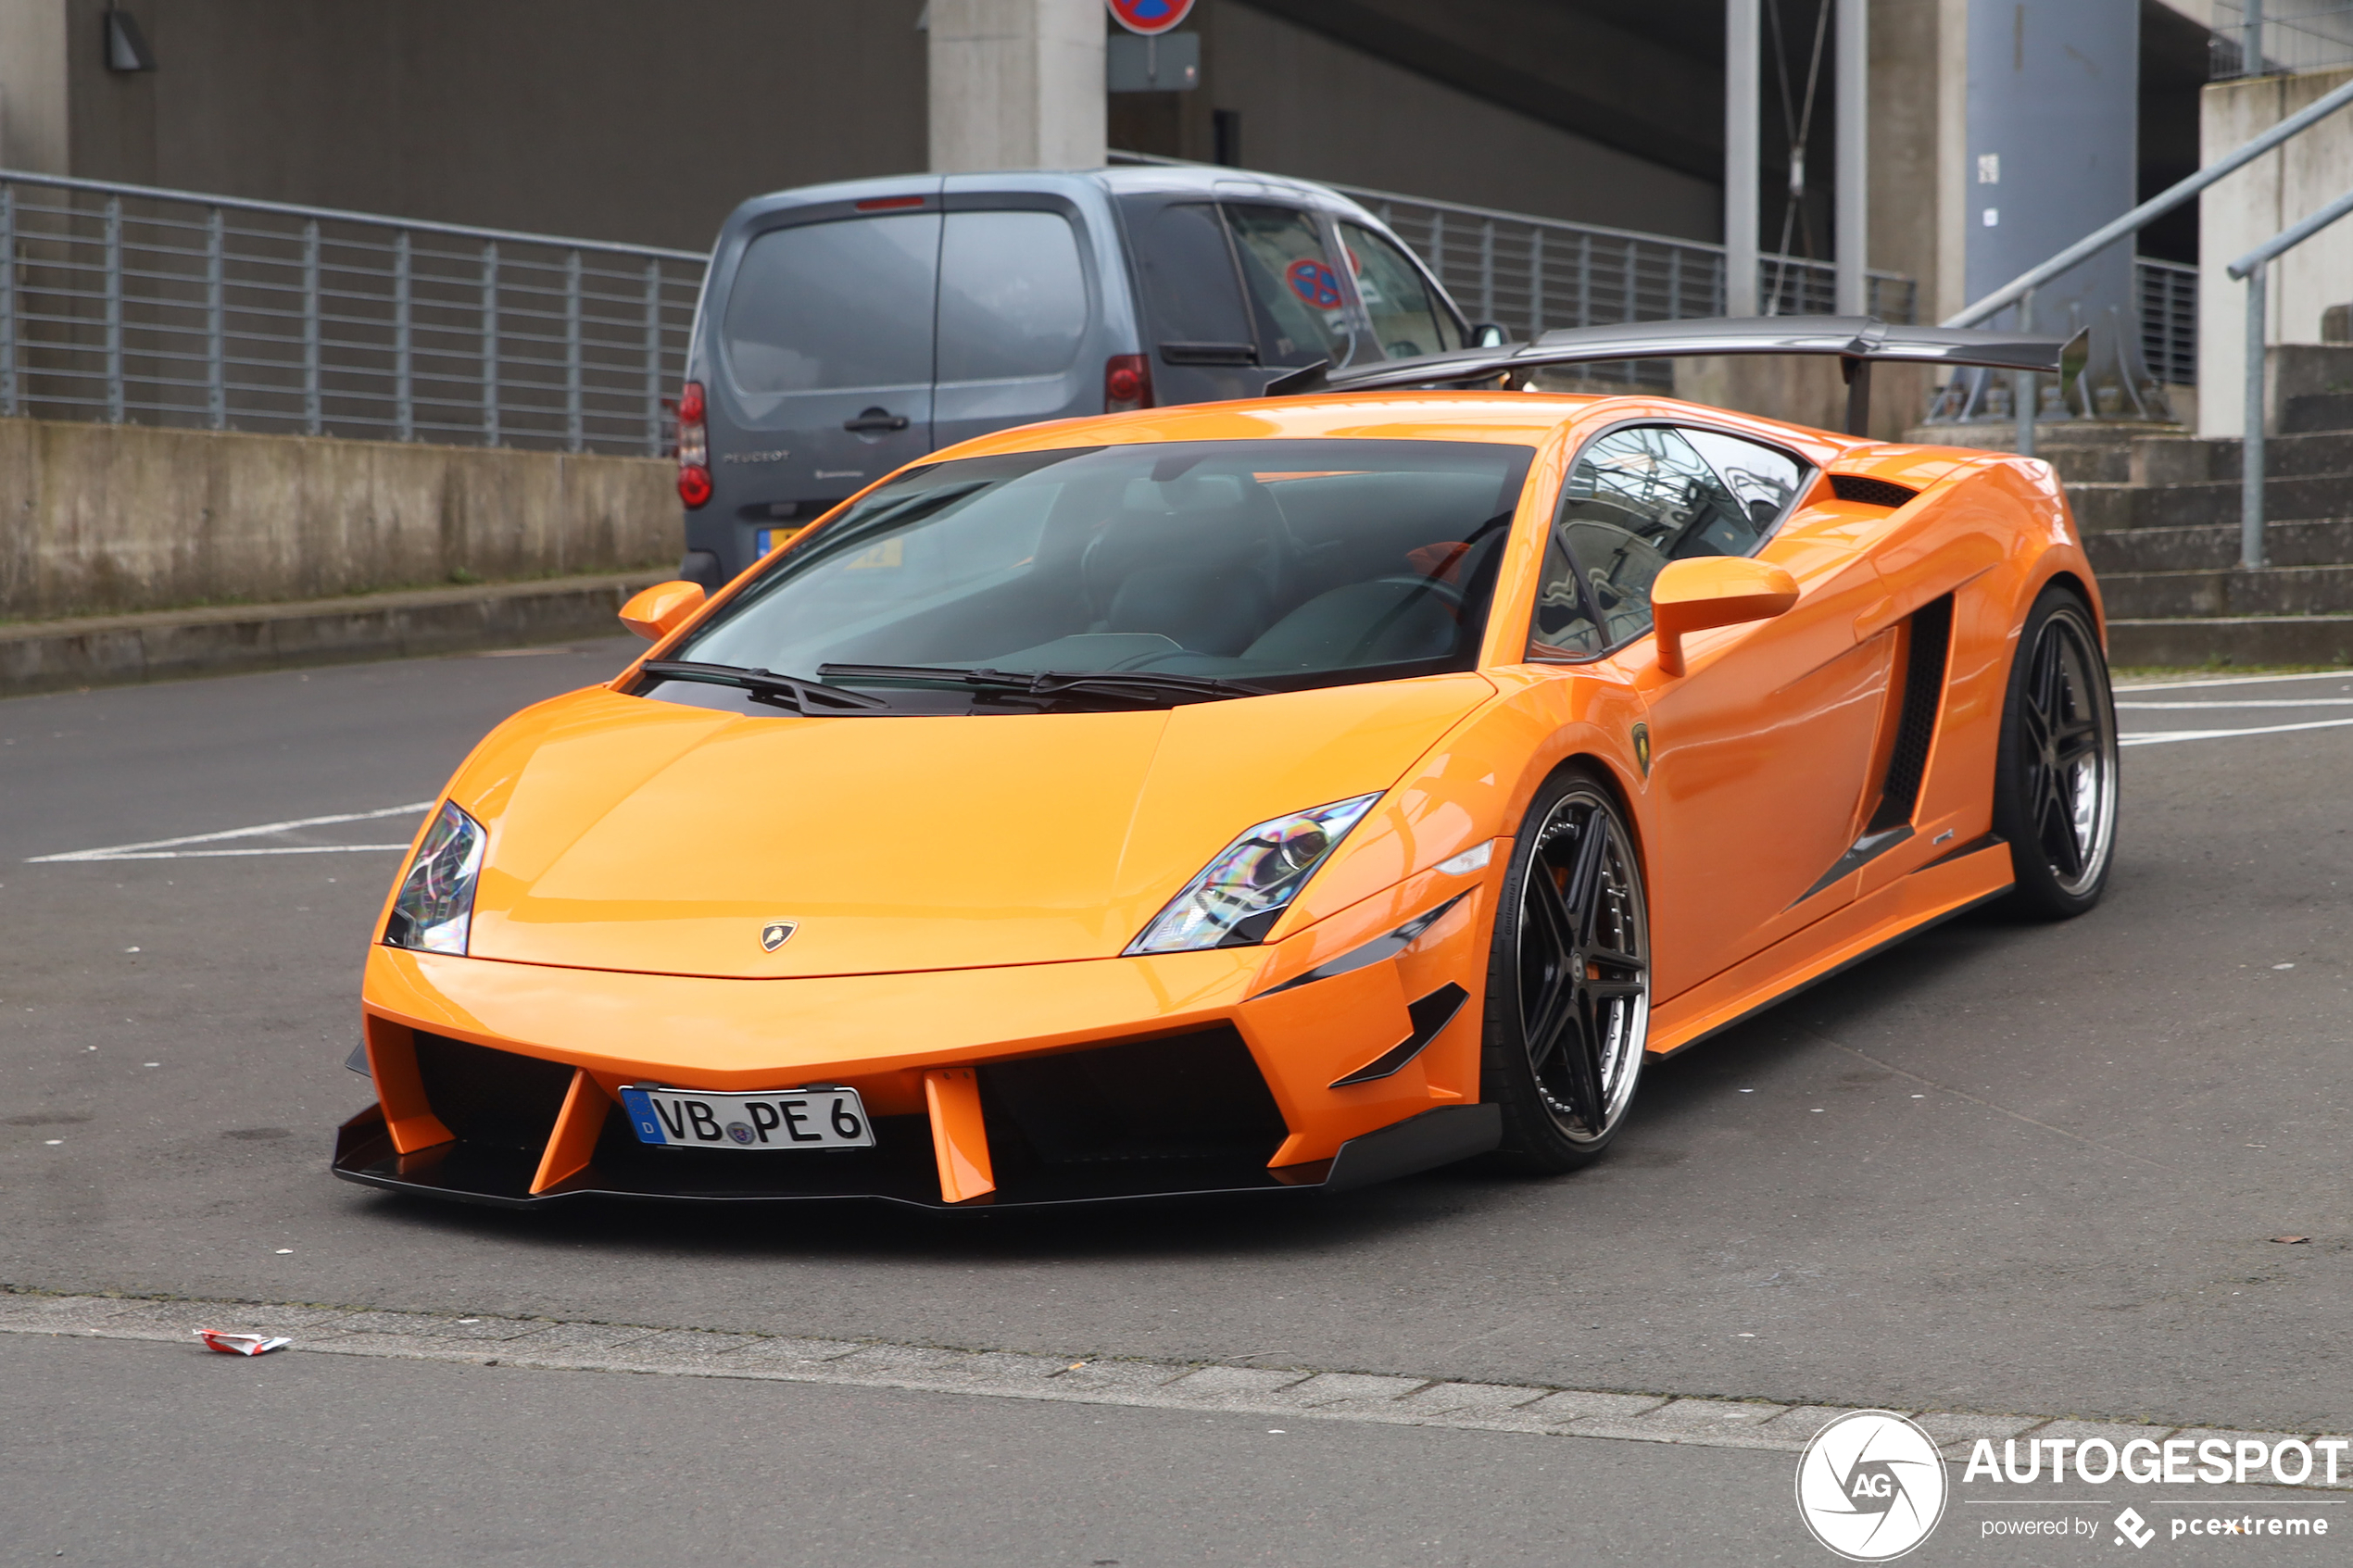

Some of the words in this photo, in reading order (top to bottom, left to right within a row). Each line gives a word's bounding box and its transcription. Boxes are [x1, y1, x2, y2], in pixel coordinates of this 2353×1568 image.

[641, 1122, 654, 1134] D
[652, 1098, 723, 1141] VB
[745, 1100, 823, 1143] PE
[831, 1098, 862, 1138] 6
